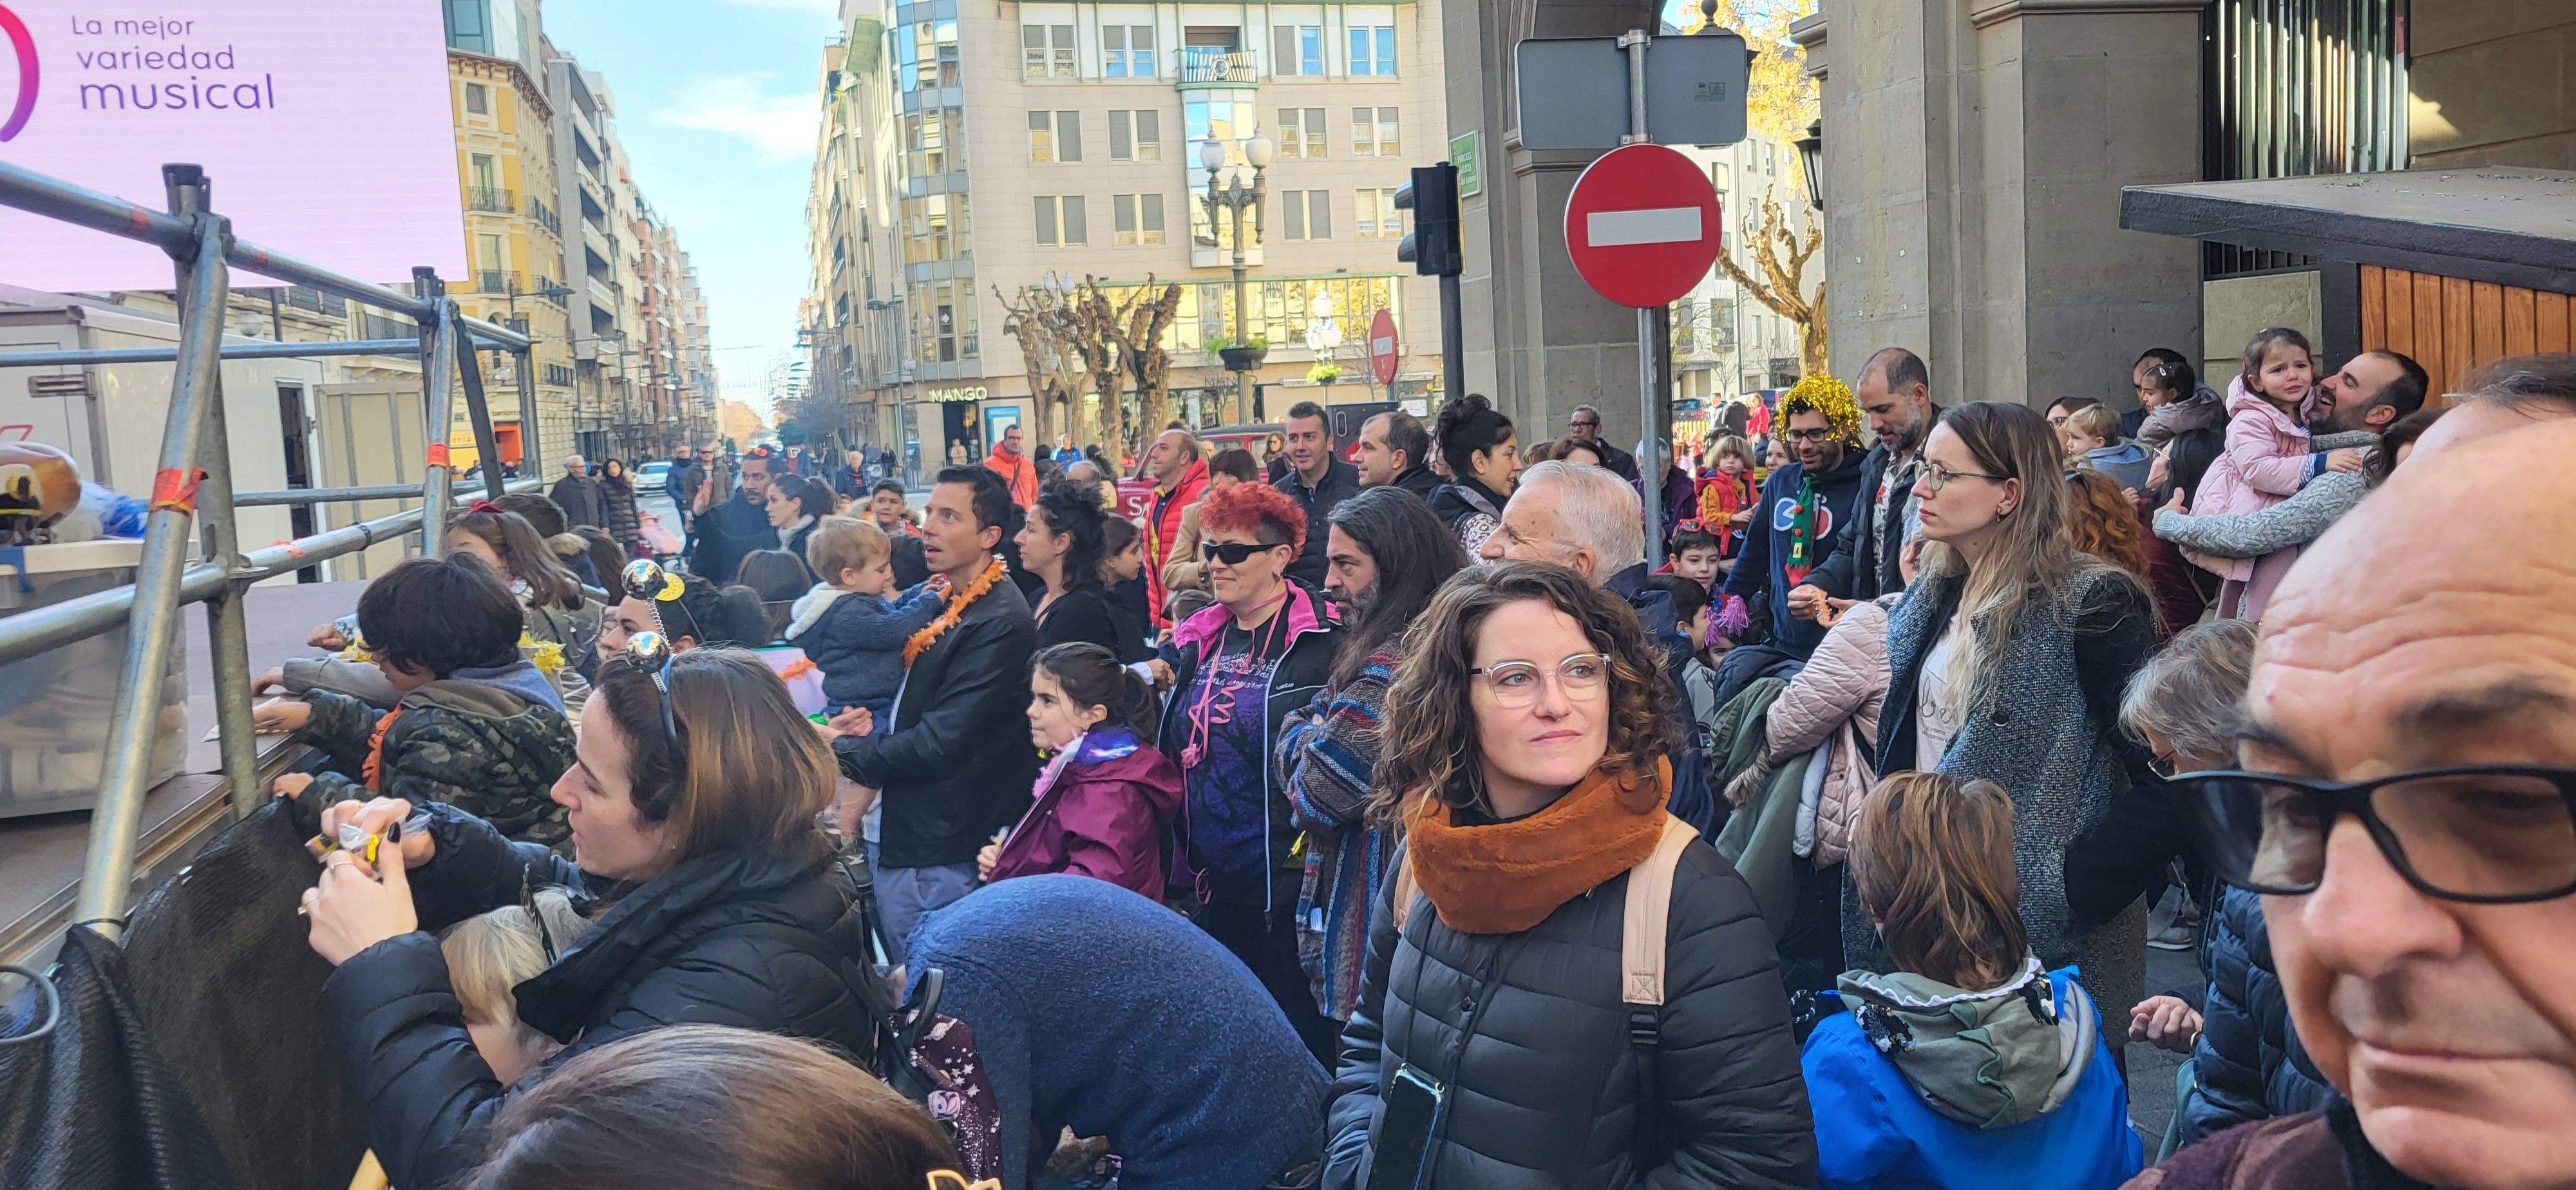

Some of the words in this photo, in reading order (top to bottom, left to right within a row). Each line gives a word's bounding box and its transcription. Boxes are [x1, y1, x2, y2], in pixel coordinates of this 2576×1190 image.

[71, 15, 102, 34] La
[114, 15, 194, 40] mejor
[76, 44, 234, 69] variedad
[80, 73, 274, 109] musical
[1460, 162, 1472, 175] ALICIA
[928, 386, 988, 402] MANGO
